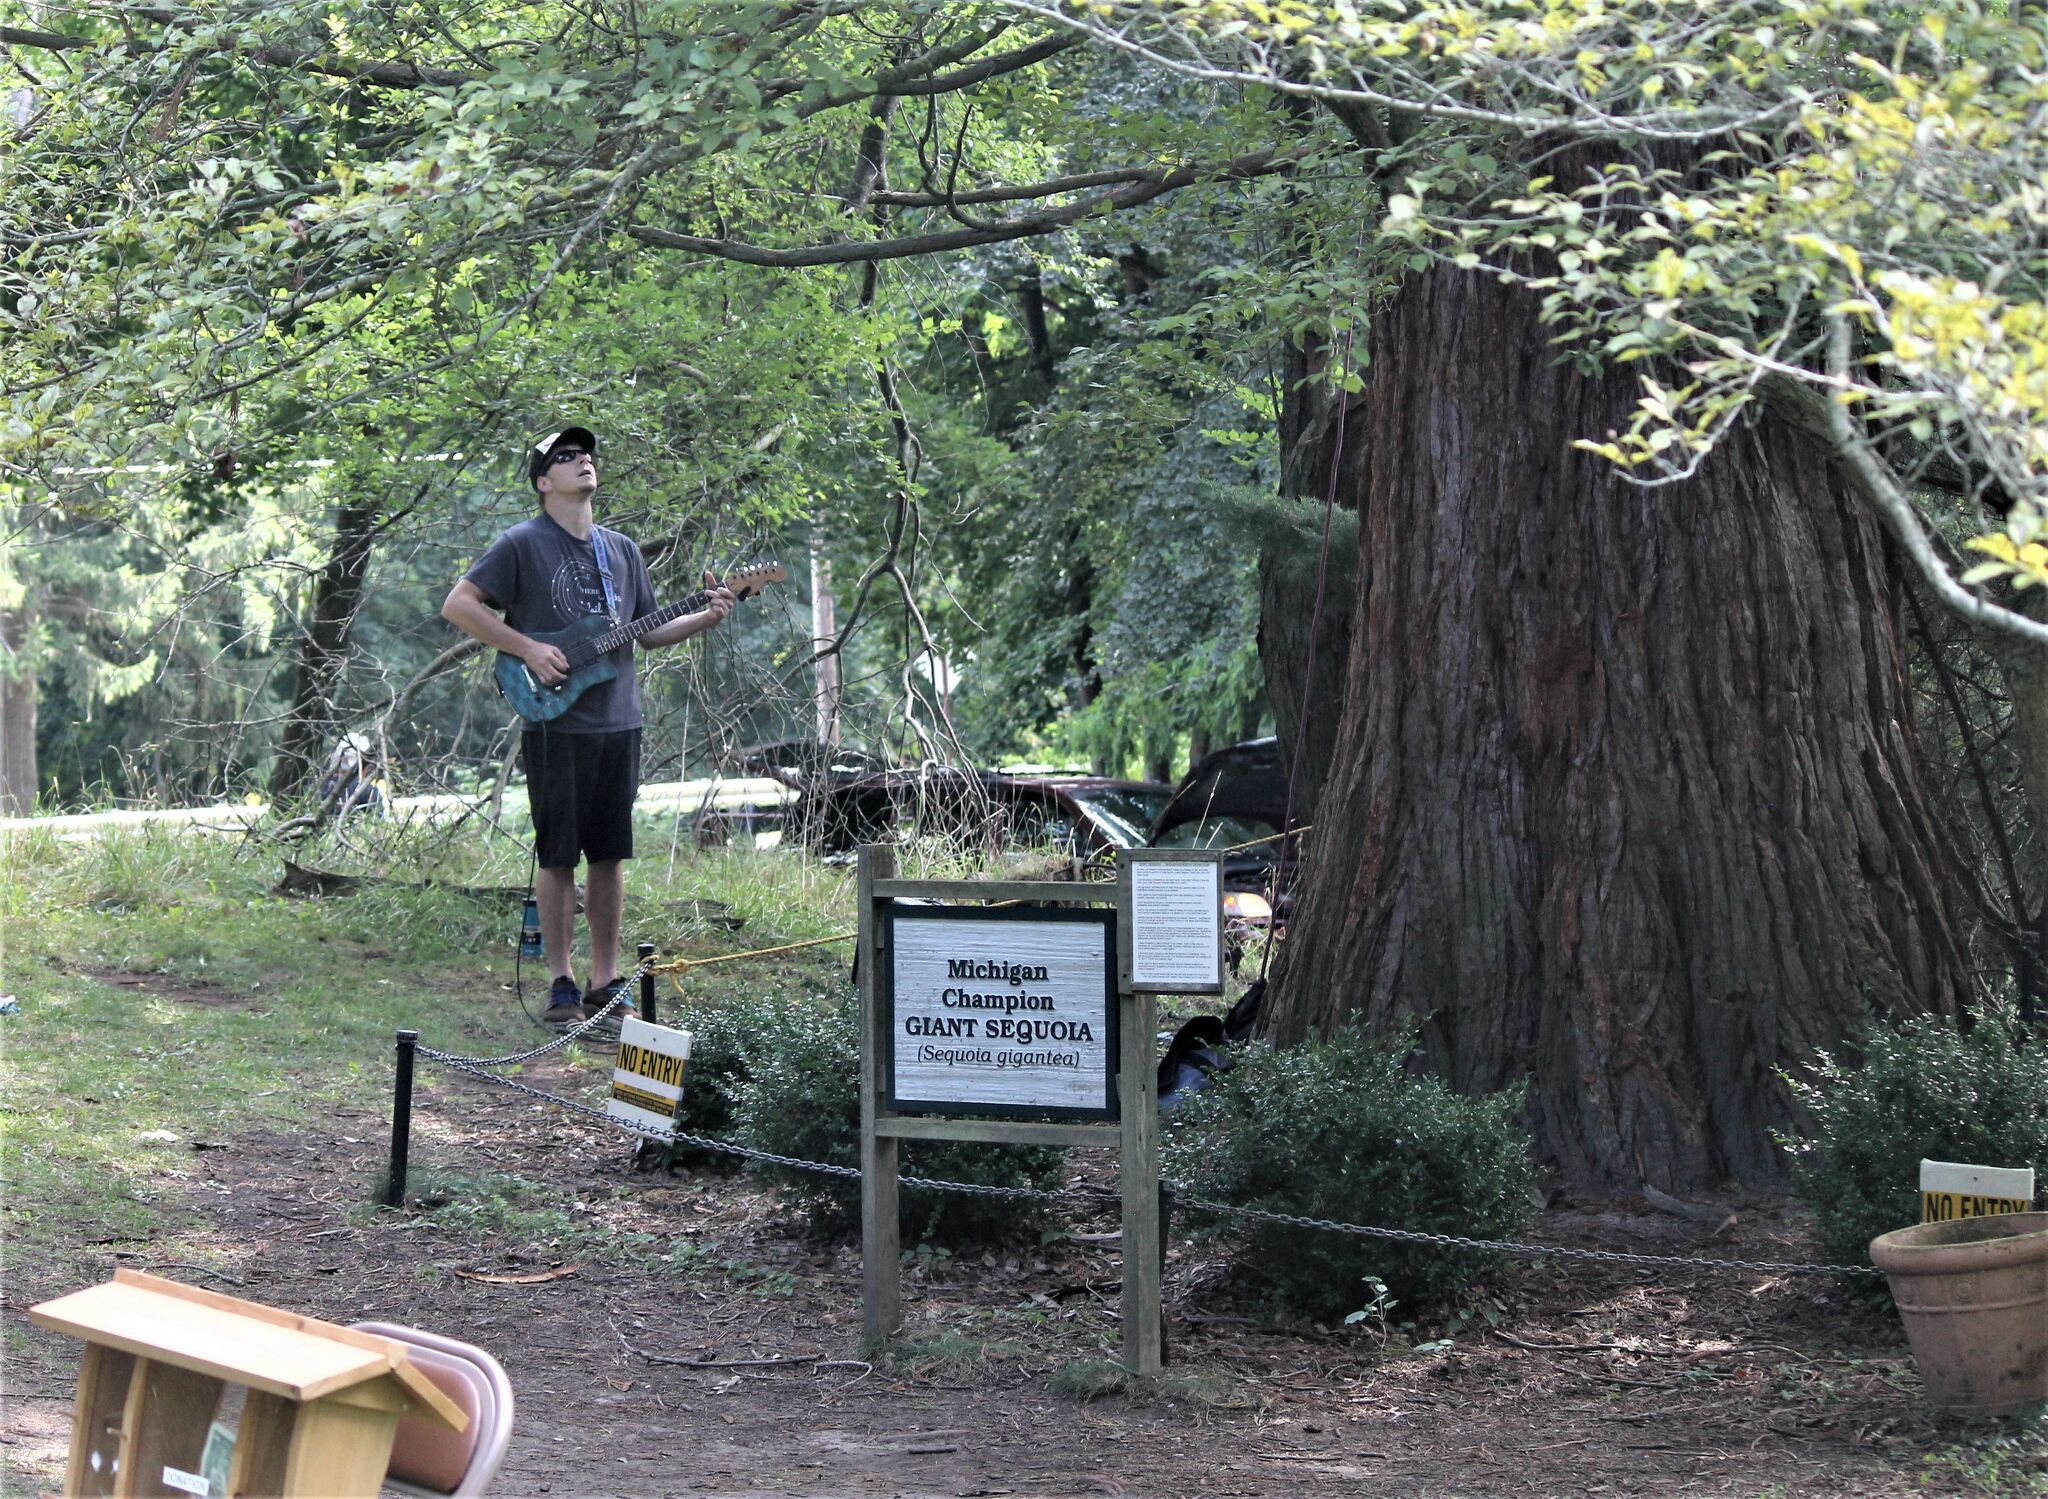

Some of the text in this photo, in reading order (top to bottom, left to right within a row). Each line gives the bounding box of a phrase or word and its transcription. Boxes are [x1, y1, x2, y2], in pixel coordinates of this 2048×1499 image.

[948, 959, 1048, 985] Michigan
[942, 988, 1054, 1014] Champion
[905, 1016, 1093, 1044] GIANT SEQUOIA
[620, 1043, 681, 1086] NO ENTRY
[917, 1044, 1080, 1068] (Sequoia gigantea)
[1927, 1193, 1952, 1222] NO
